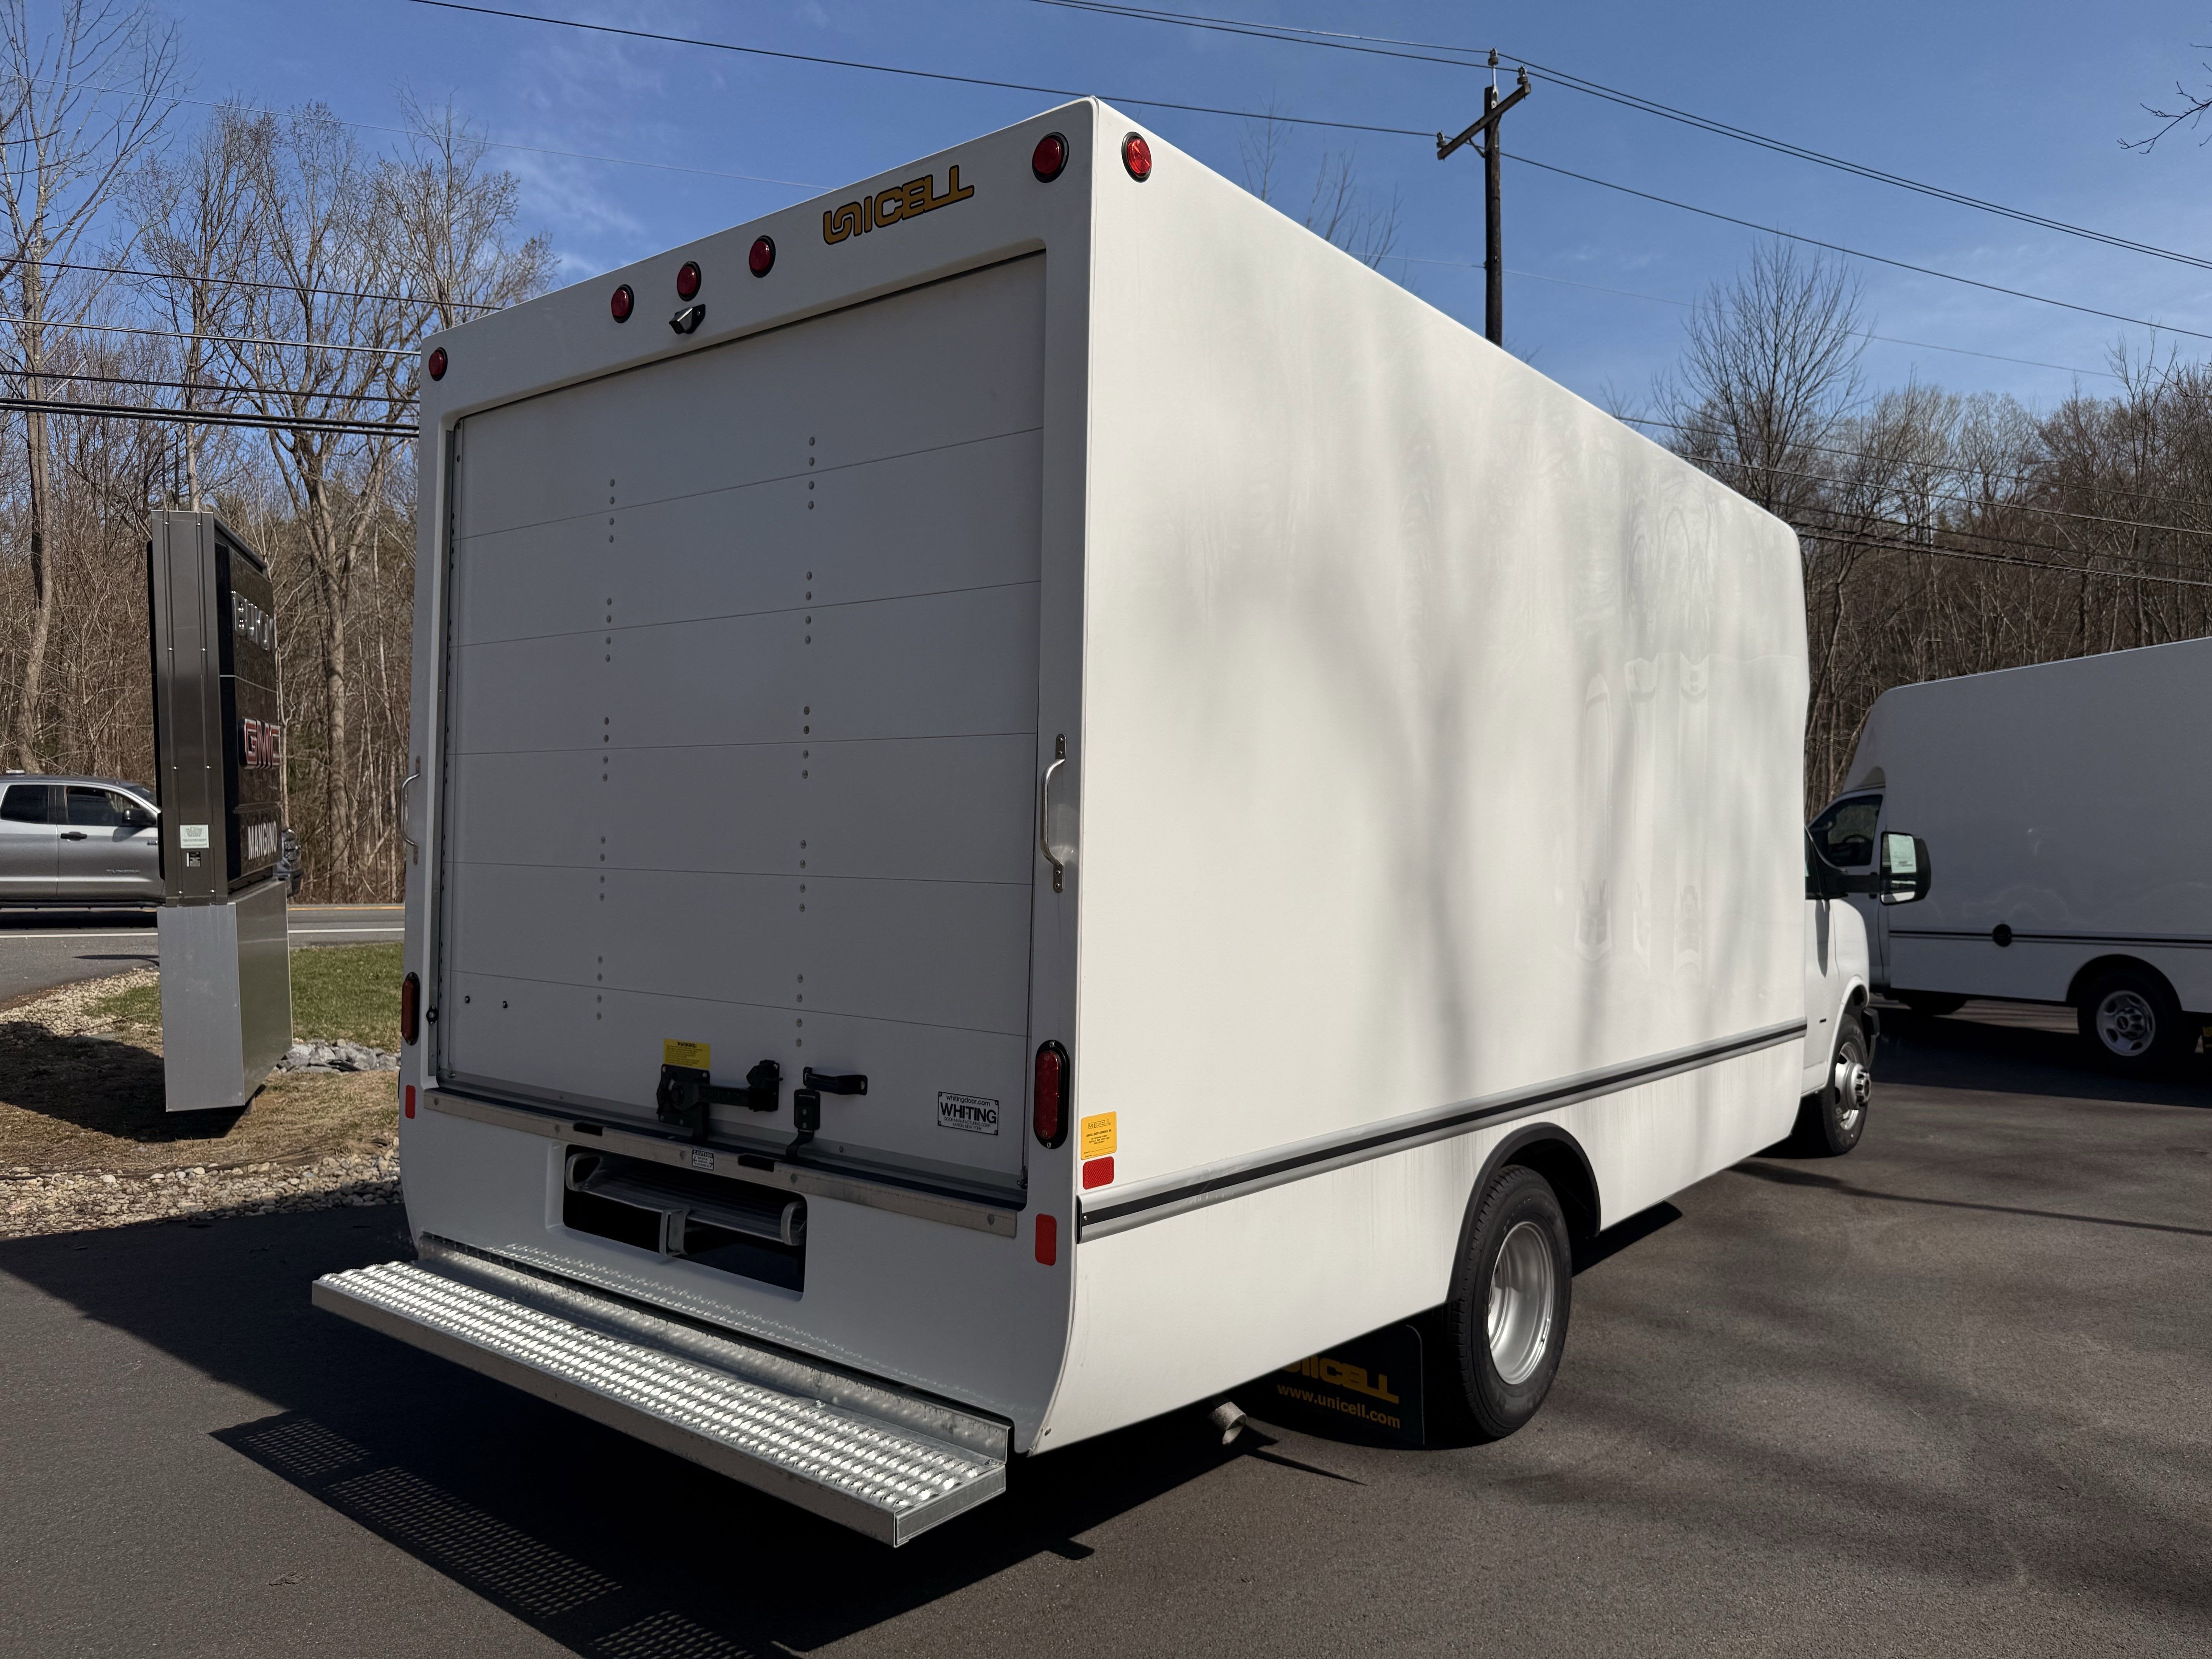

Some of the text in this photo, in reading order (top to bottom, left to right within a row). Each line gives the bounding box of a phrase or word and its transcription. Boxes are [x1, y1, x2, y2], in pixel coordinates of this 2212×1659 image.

[823, 165, 974, 245] UNICELL
[244, 719, 280, 766] GMC
[248, 820, 277, 860] MANGINO
[940, 1102, 997, 1124] WHITING
[946, 1095, 990, 1106] whitingdoor.com
[1277, 1384, 1400, 1429] www.unicell.com
